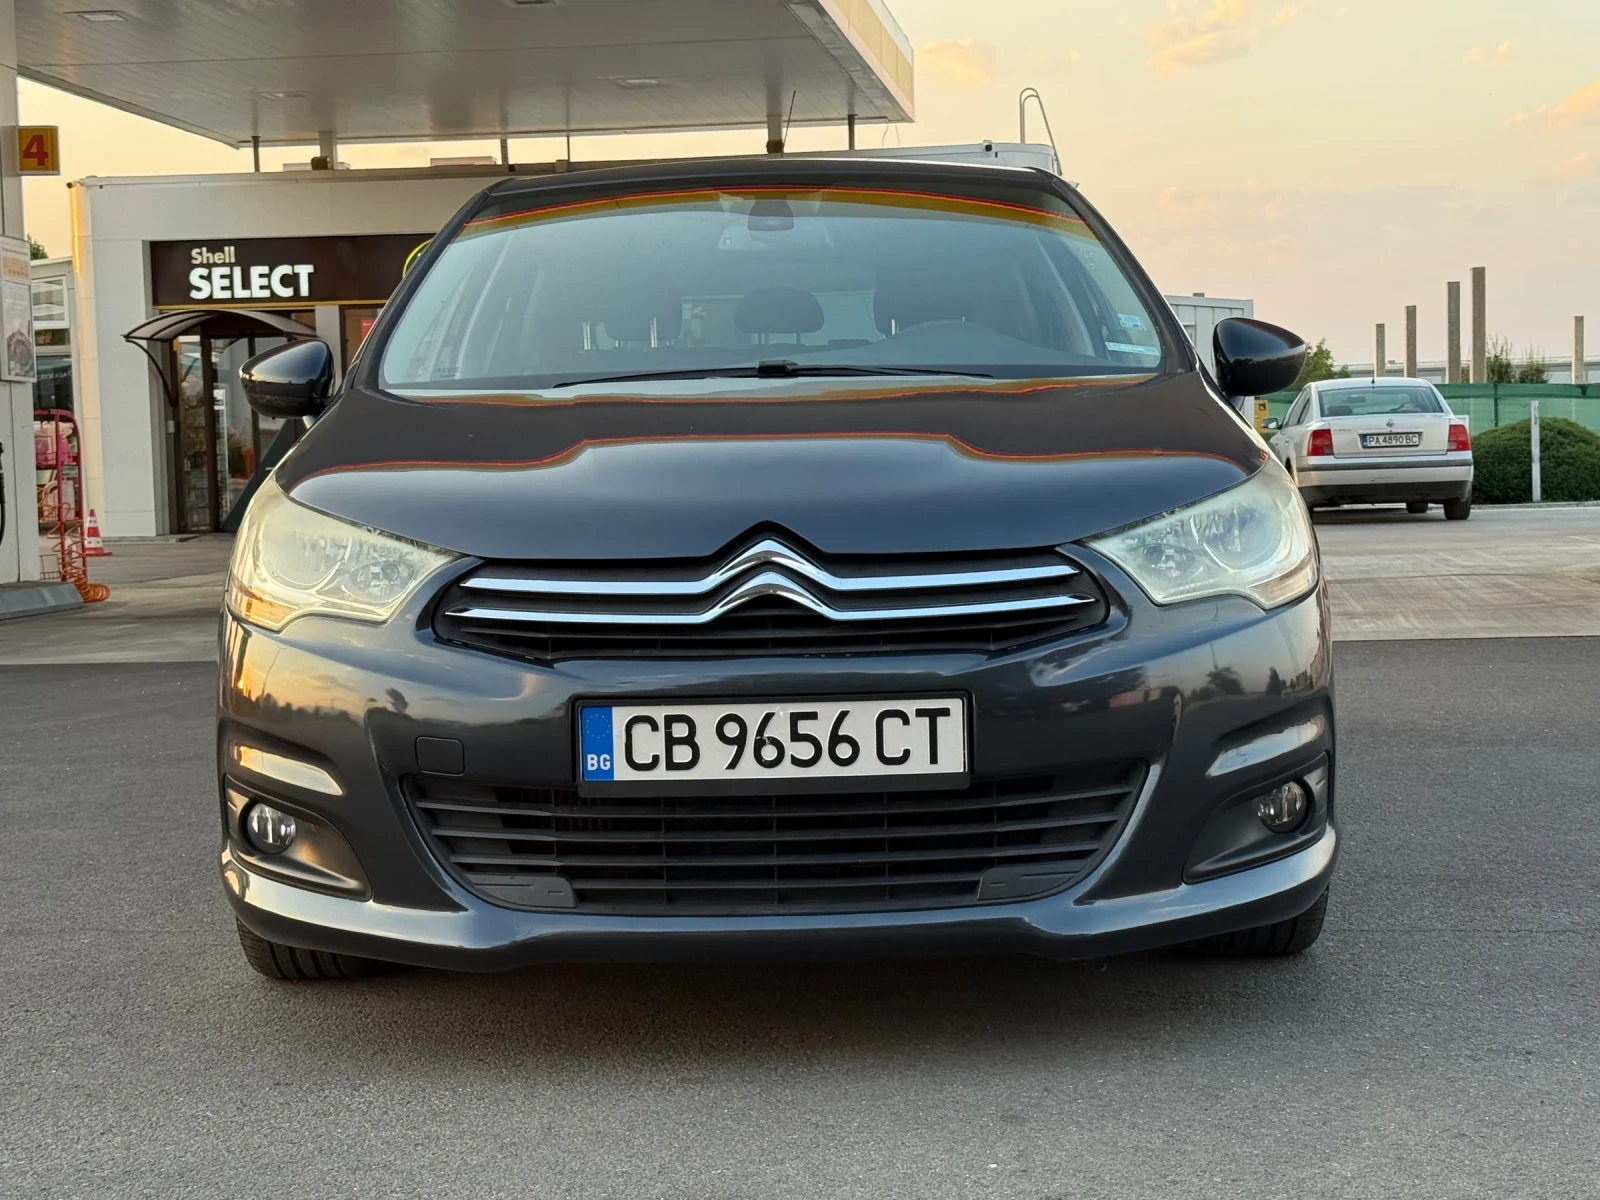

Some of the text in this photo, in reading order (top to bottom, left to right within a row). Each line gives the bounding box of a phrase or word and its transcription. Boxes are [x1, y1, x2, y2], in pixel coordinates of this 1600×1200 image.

[22, 134, 49, 166] 4
[191, 246, 236, 264] Shell
[189, 264, 315, 300] SELECT
[1368, 434, 1418, 445] PA 4890 BC
[624, 708, 952, 771] CB 9656 CT
[586, 753, 612, 771] BG
